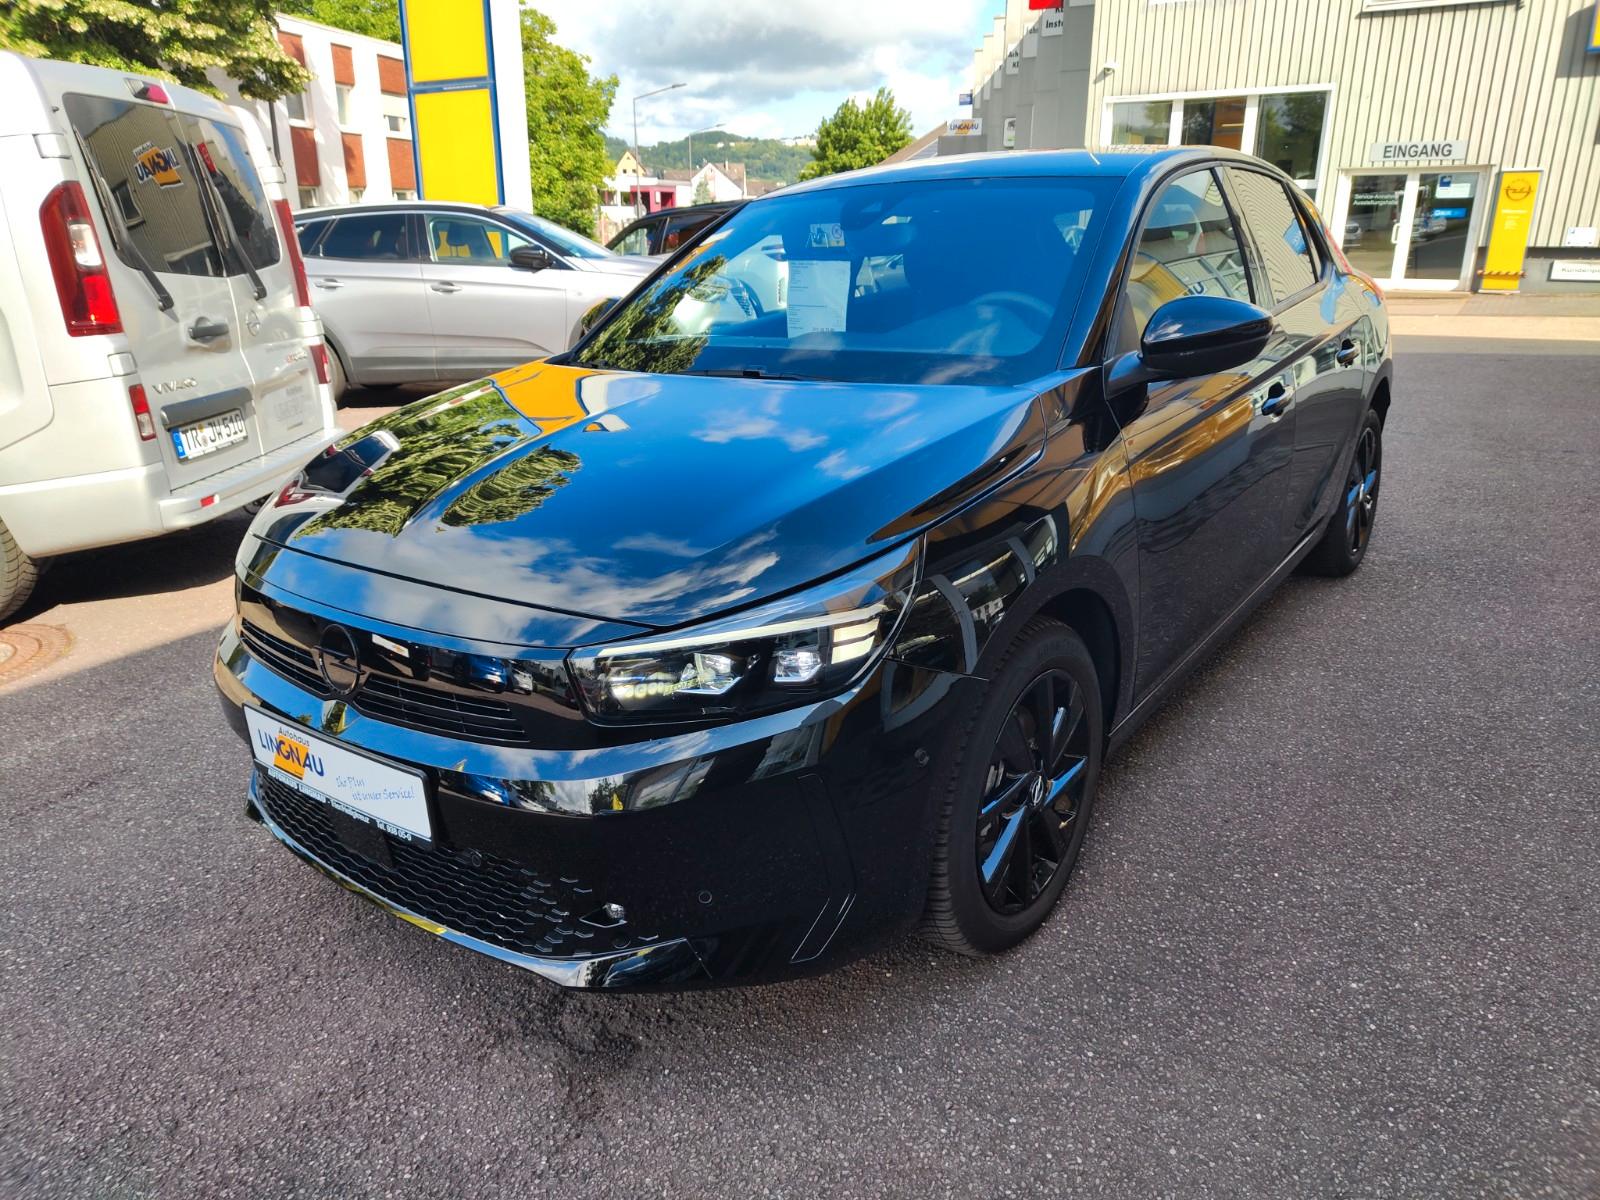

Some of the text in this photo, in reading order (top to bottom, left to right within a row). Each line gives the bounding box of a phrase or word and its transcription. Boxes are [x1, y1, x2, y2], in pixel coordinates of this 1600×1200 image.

[1383, 143, 1453, 159] EINGANG
[182, 427, 202, 450] TR
[223, 413, 244, 437] 510
[279, 726, 310, 747] Autohaus
[258, 728, 324, 777] LINGNAU
